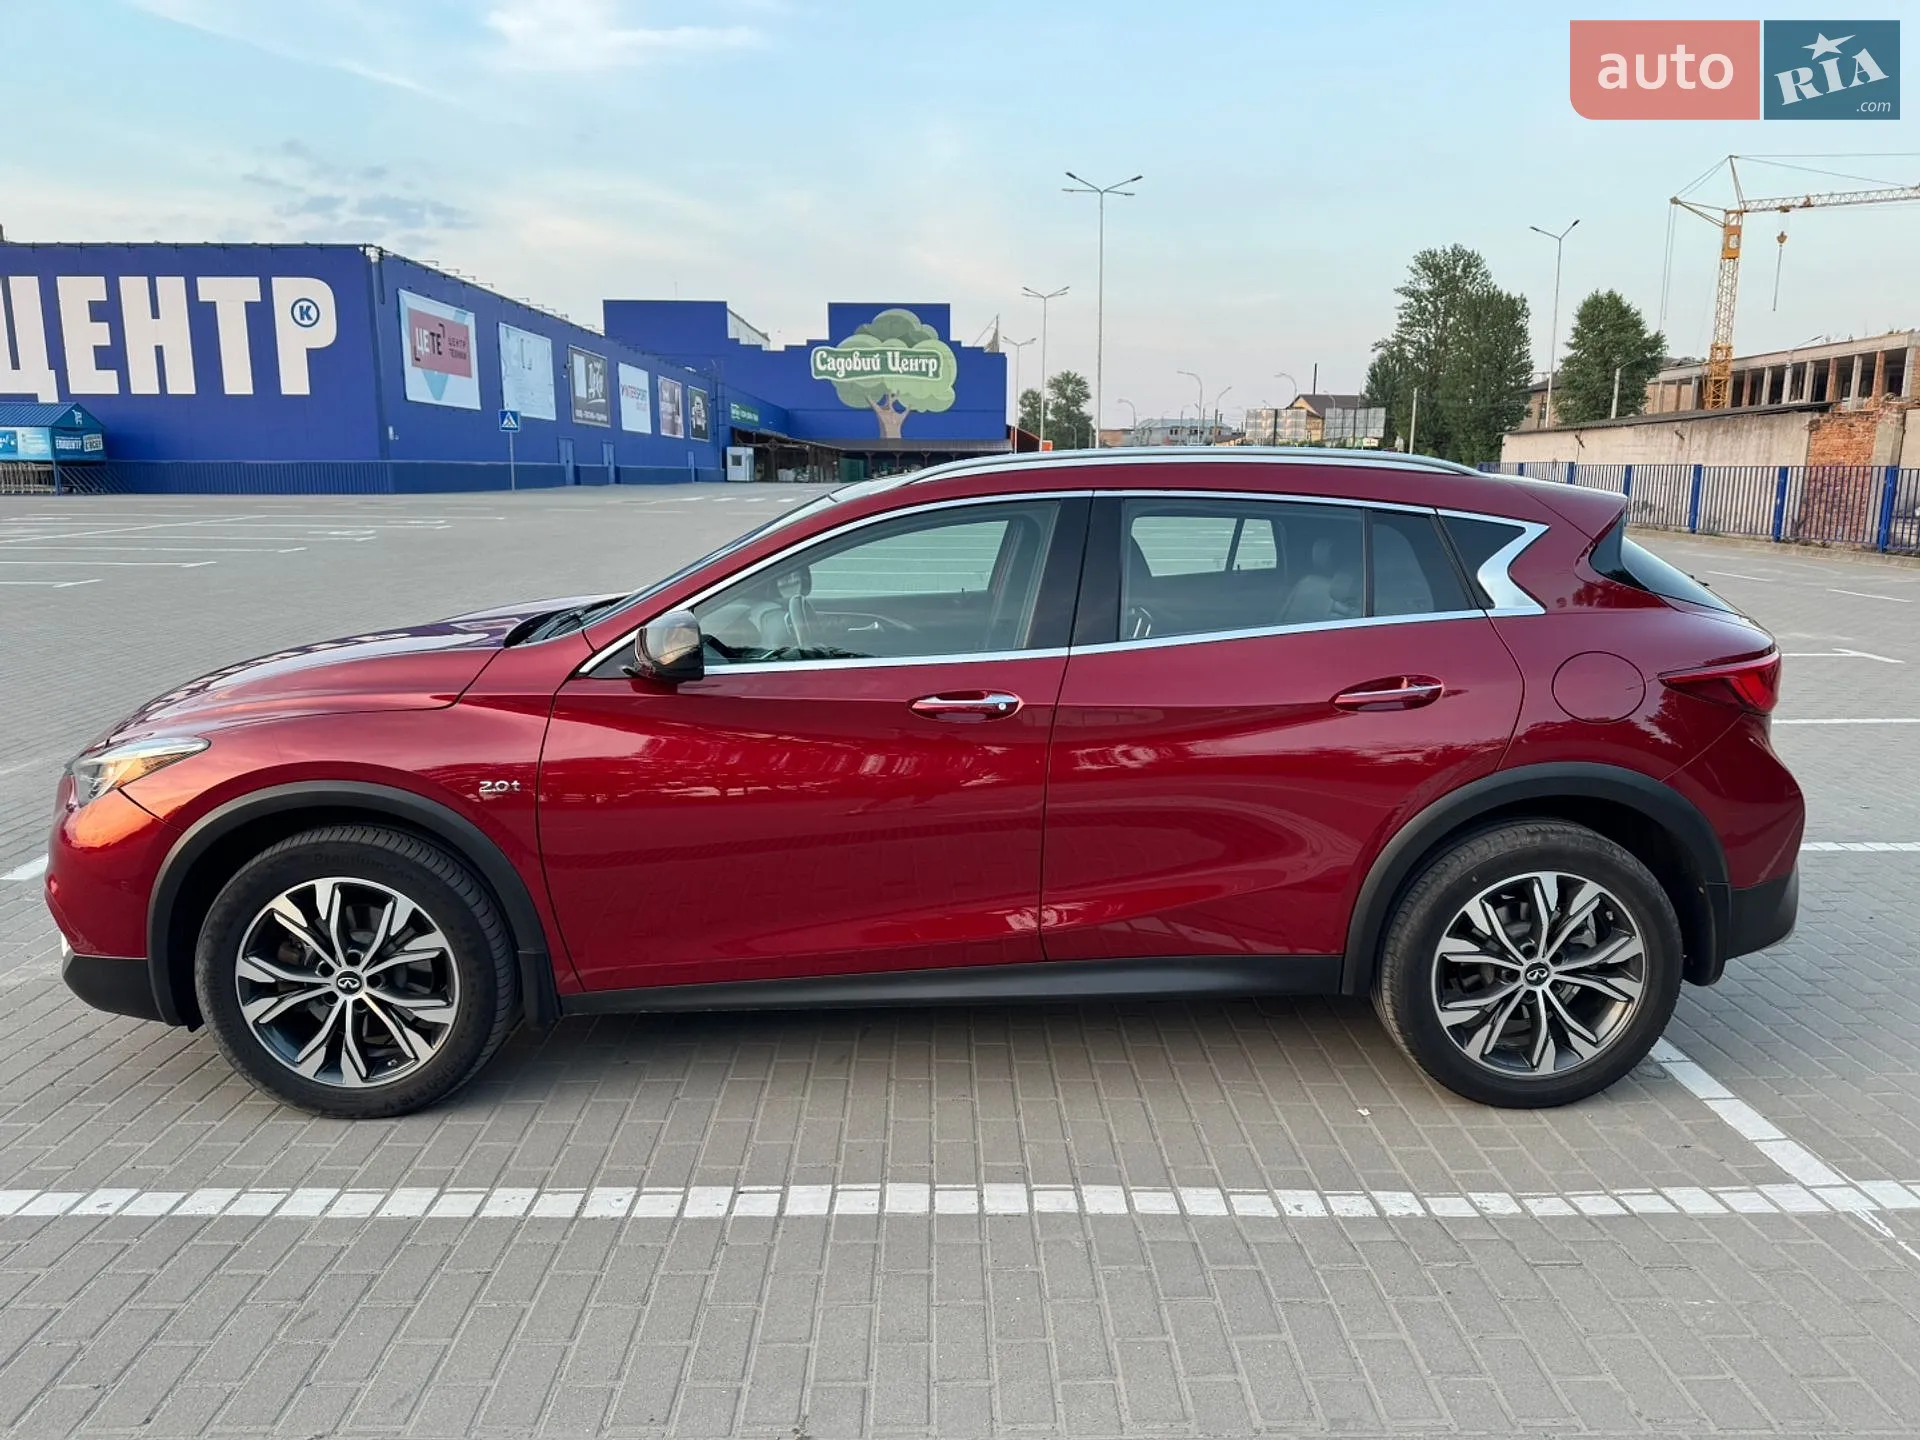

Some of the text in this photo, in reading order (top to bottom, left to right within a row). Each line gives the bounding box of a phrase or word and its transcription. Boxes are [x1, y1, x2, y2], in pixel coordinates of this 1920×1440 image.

[0, 275, 337, 403] ЦЕНТР
[815, 350, 939, 378] Садовий Центр
